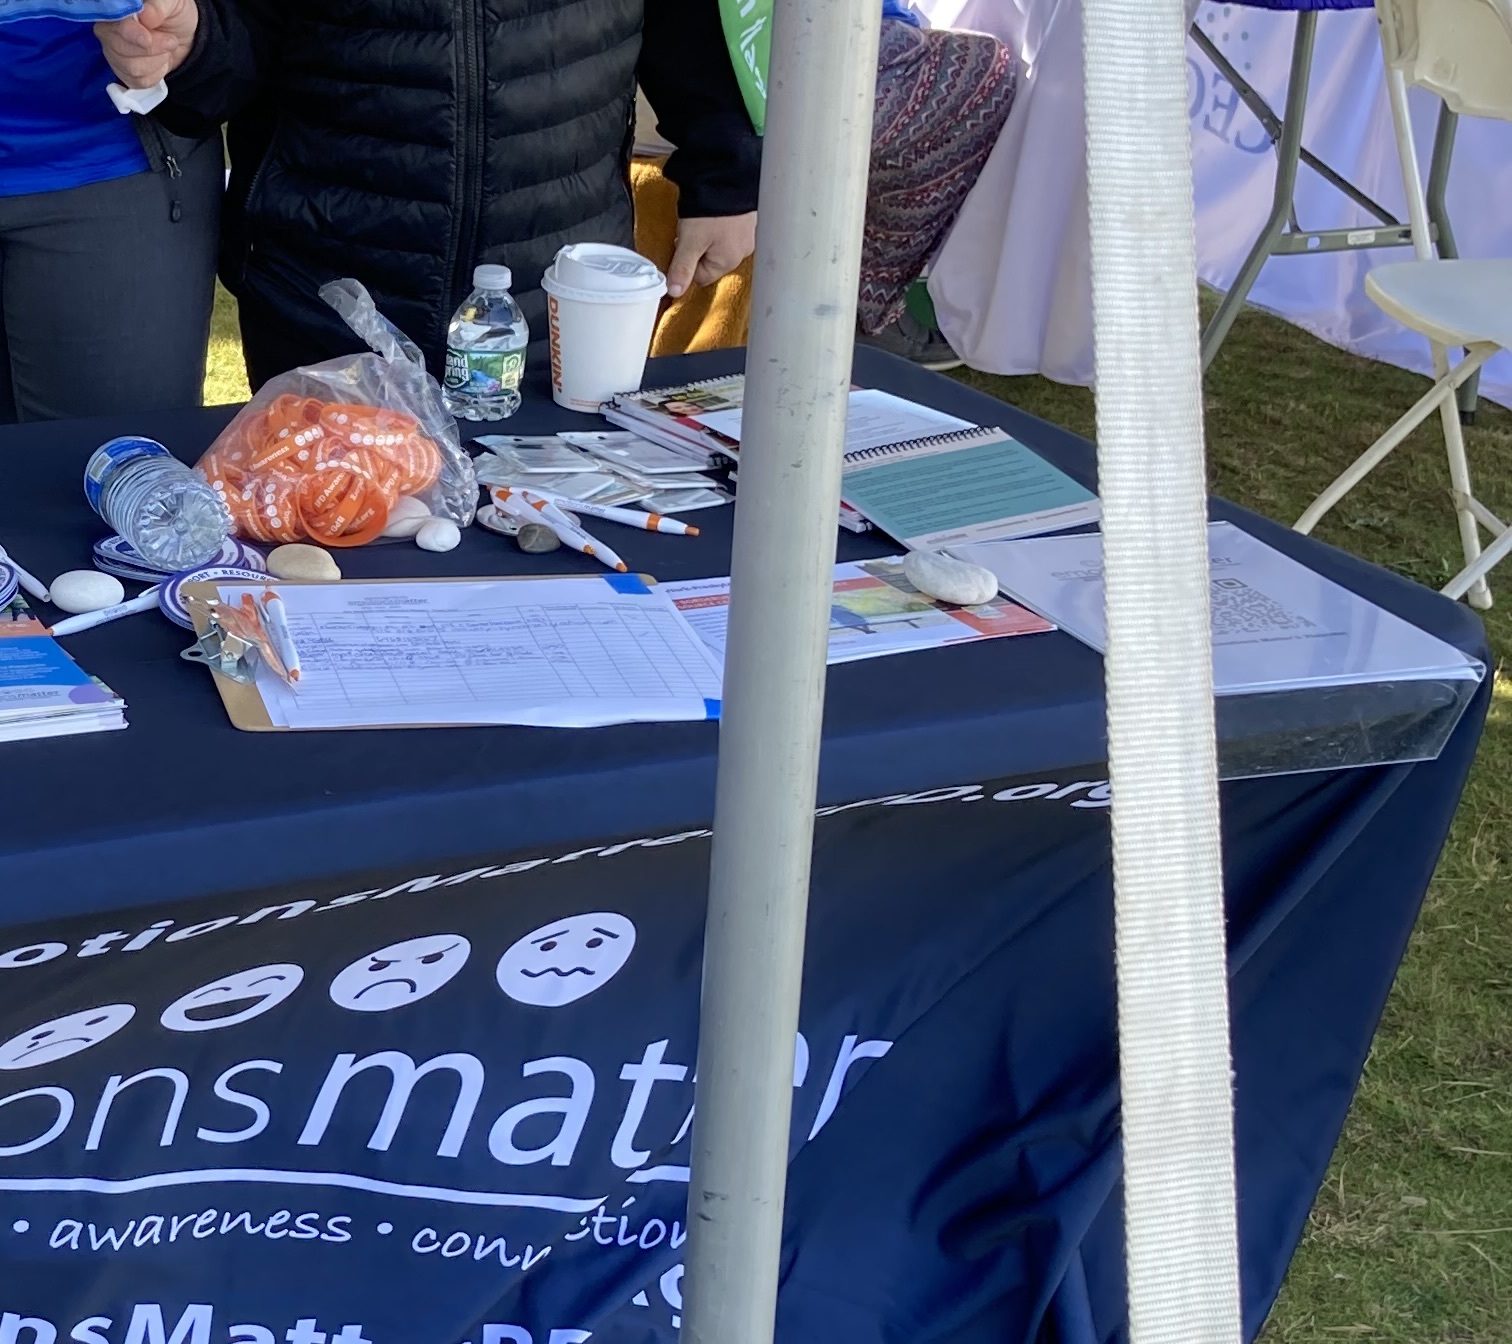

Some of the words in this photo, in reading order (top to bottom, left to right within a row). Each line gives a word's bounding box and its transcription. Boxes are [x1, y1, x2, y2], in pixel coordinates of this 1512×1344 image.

[548, 294, 564, 395] DUNKIN'
[251, 444, 291, 471] Awareness
[48, 1202, 352, 1254] awareness
